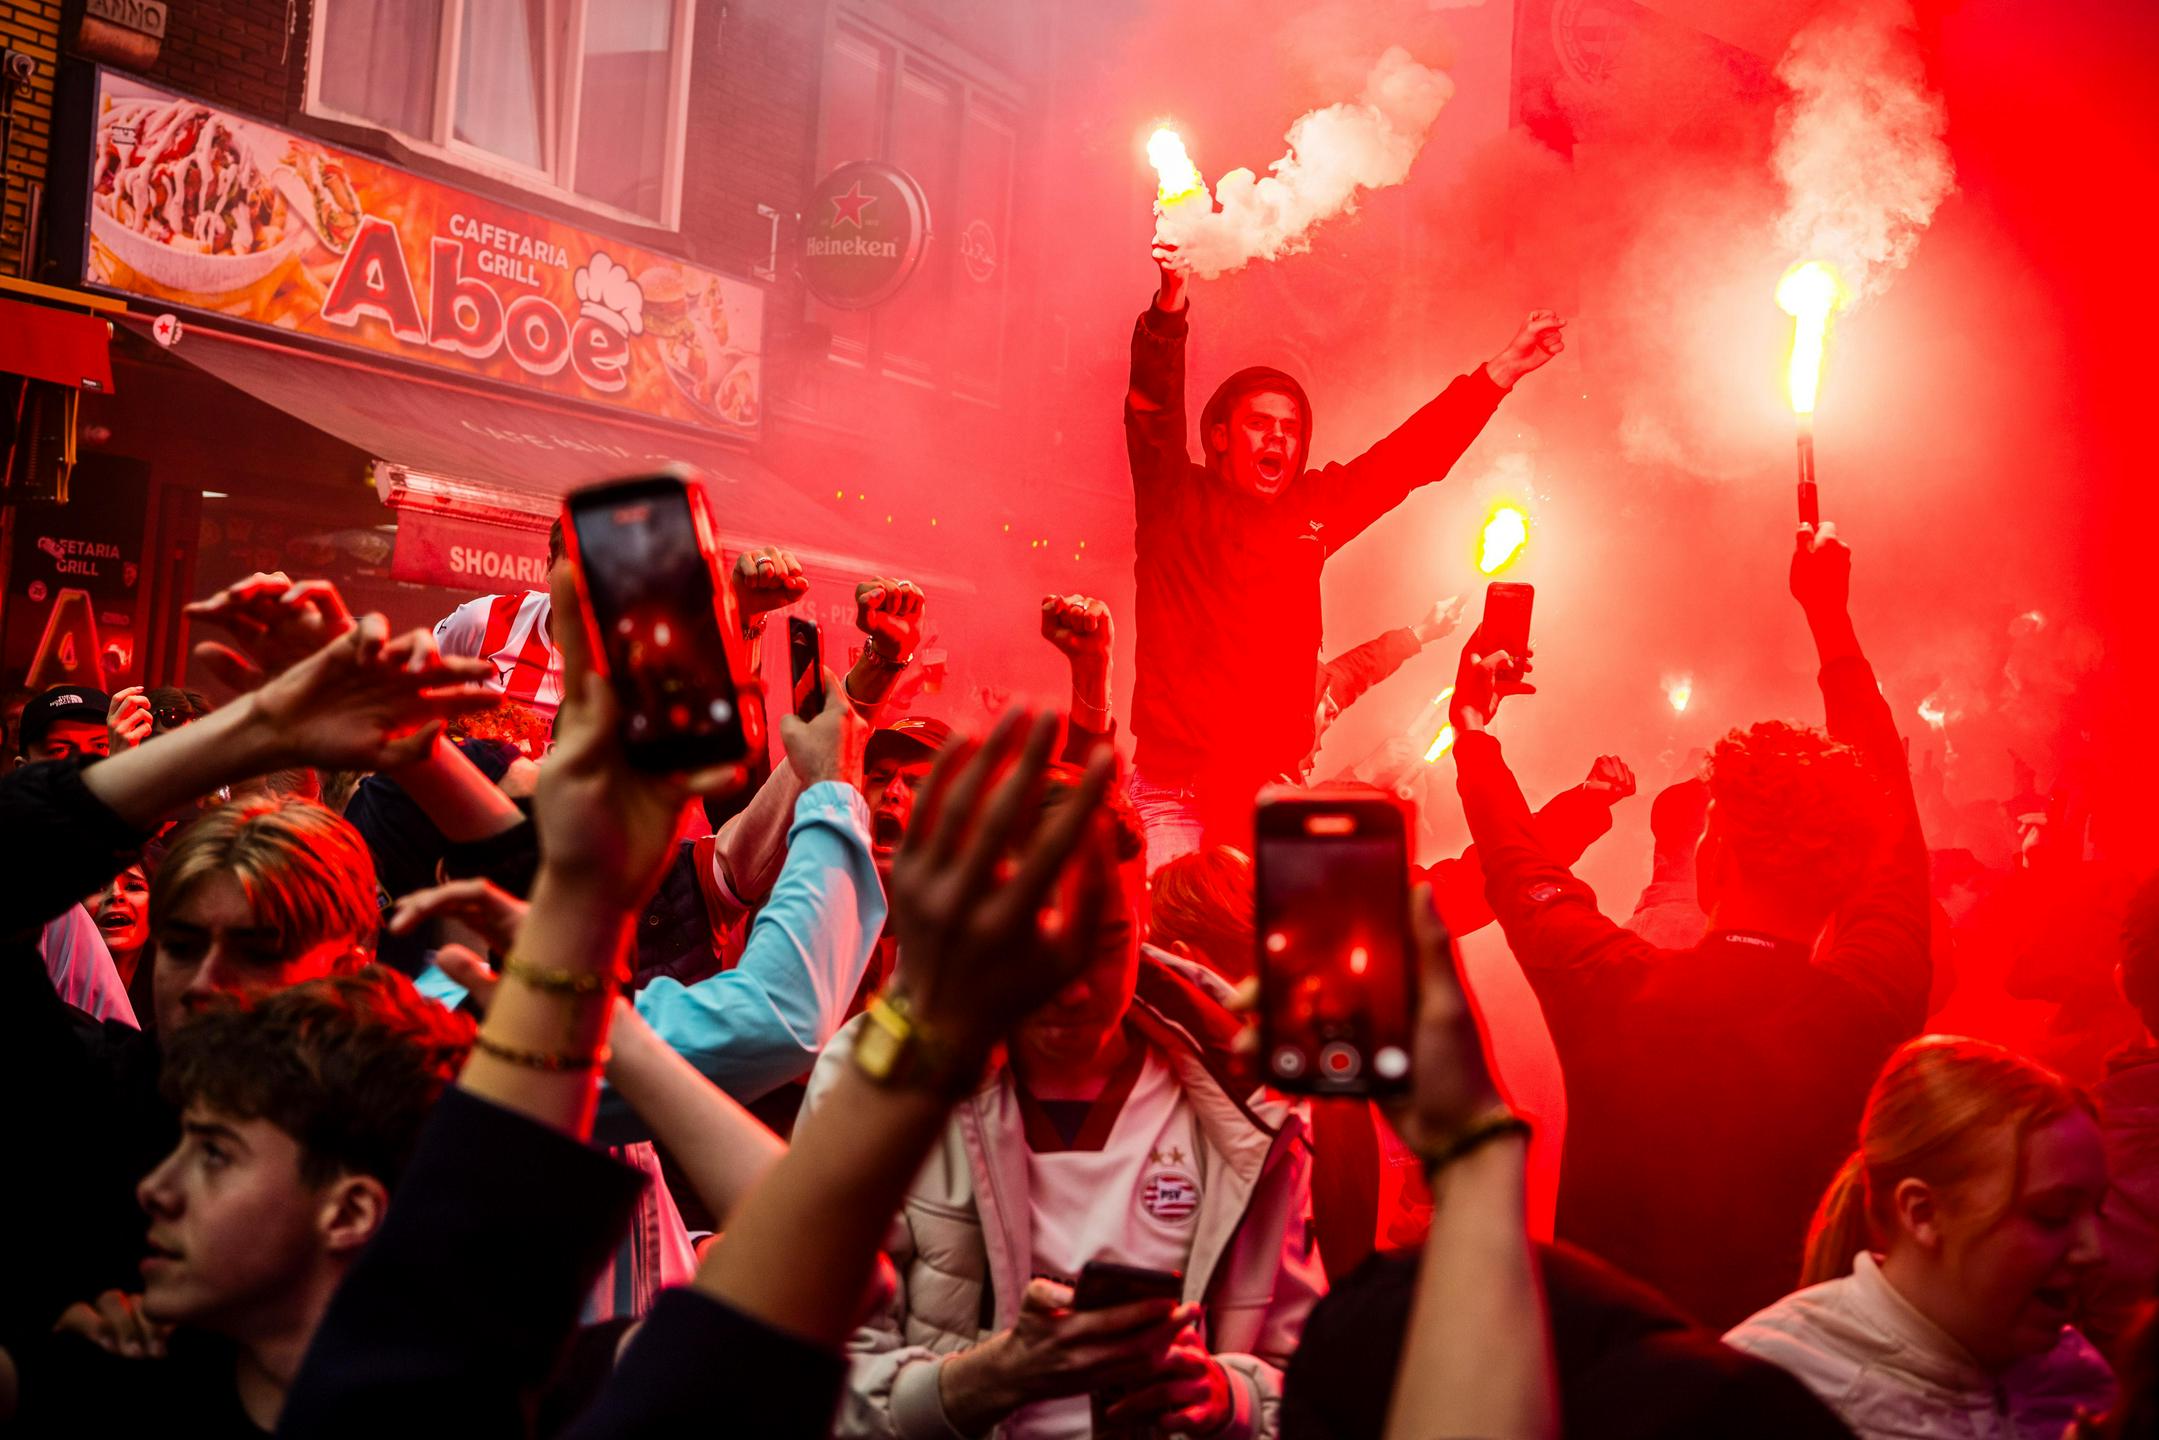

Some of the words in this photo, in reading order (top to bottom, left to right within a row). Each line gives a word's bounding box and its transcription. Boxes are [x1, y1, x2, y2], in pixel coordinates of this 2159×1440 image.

[450, 214, 569, 270] CAFETARIA
[806, 236, 897, 257] Heineken
[477, 250, 540, 288] GRILL
[320, 214, 629, 392] Aboe
[56, 559, 99, 576] GRILL
[1160, 1189, 1182, 1201] PSV
